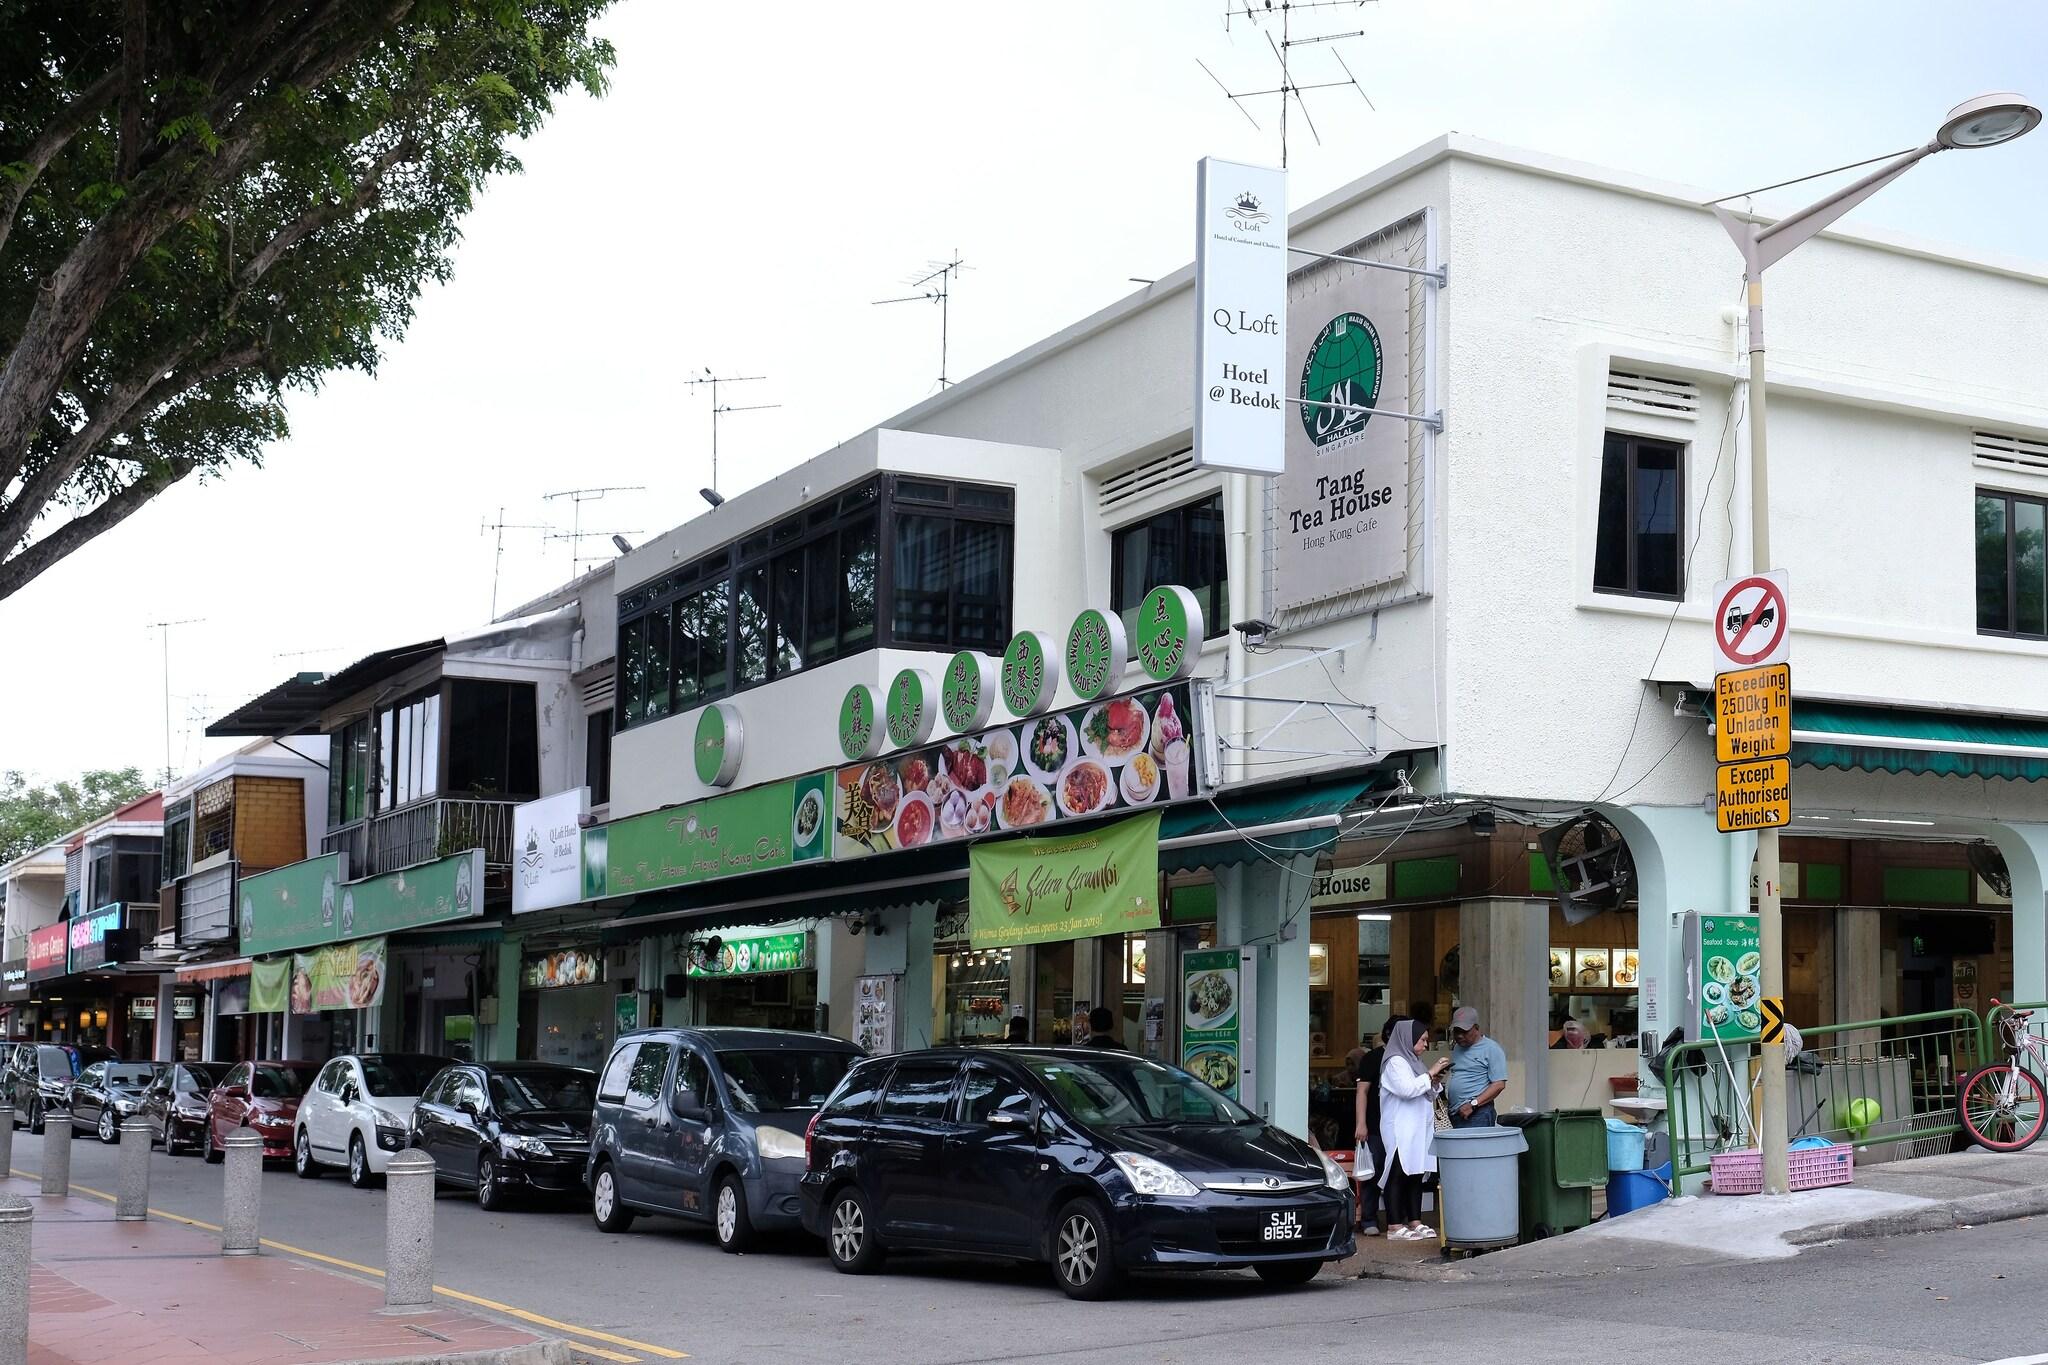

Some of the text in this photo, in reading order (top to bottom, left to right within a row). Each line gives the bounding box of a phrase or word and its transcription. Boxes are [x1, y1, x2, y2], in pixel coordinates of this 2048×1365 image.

[1214, 233, 1228, 241] Hotel
[1234, 220, 1261, 232] Q Loft
[1213, 308, 1279, 335] Q Loft
[1222, 362, 1268, 385] Hotel
[1209, 385, 1281, 410] @ Bedok
[1316, 432, 1365, 457] SINGAPORE
[1327, 427, 1354, 443] HALAL
[1316, 468, 1365, 500] Tang
[1289, 486, 1393, 534] Tea House
[1303, 518, 1378, 551] Hong Kong Cafe
[1070, 628, 1082, 668] HOME
[1142, 637, 1184, 672] DIM SUM
[1017, 640, 1030, 692] 西餐
[1093, 656, 1109, 688] SOYA
[1005, 655, 1041, 710] WESTERN FOOD
[1073, 669, 1091, 691] MADE
[1720, 671, 1785, 695] Exceeding
[945, 691, 971, 727] CHICKEN
[1722, 691, 1786, 716] 2500kg In
[903, 704, 921, 741] LEMAK
[1726, 715, 1779, 735] Unladen
[843, 723, 871, 754] SEAFOOD
[1731, 733, 1775, 756] Weight
[1730, 763, 1775, 785] Except
[1718, 783, 1789, 807] Authorised
[1726, 807, 1780, 827] Vehicles
[721, 843, 751, 869] Kong
[1319, 877, 1371, 896] House
[1766, 880, 1771, 897] 1
[1024, 922, 1041, 935] Serai
[1041, 922, 1058, 937] opens
[1060, 922, 1068, 933] 23
[1068, 918, 1082, 932] Jan
[1703, 938, 1723, 946] Seafood
[1727, 938, 1739, 947] Soup
[1271, 1212, 1296, 1226] SJH
[1264, 1225, 1302, 1240] 8155Z
